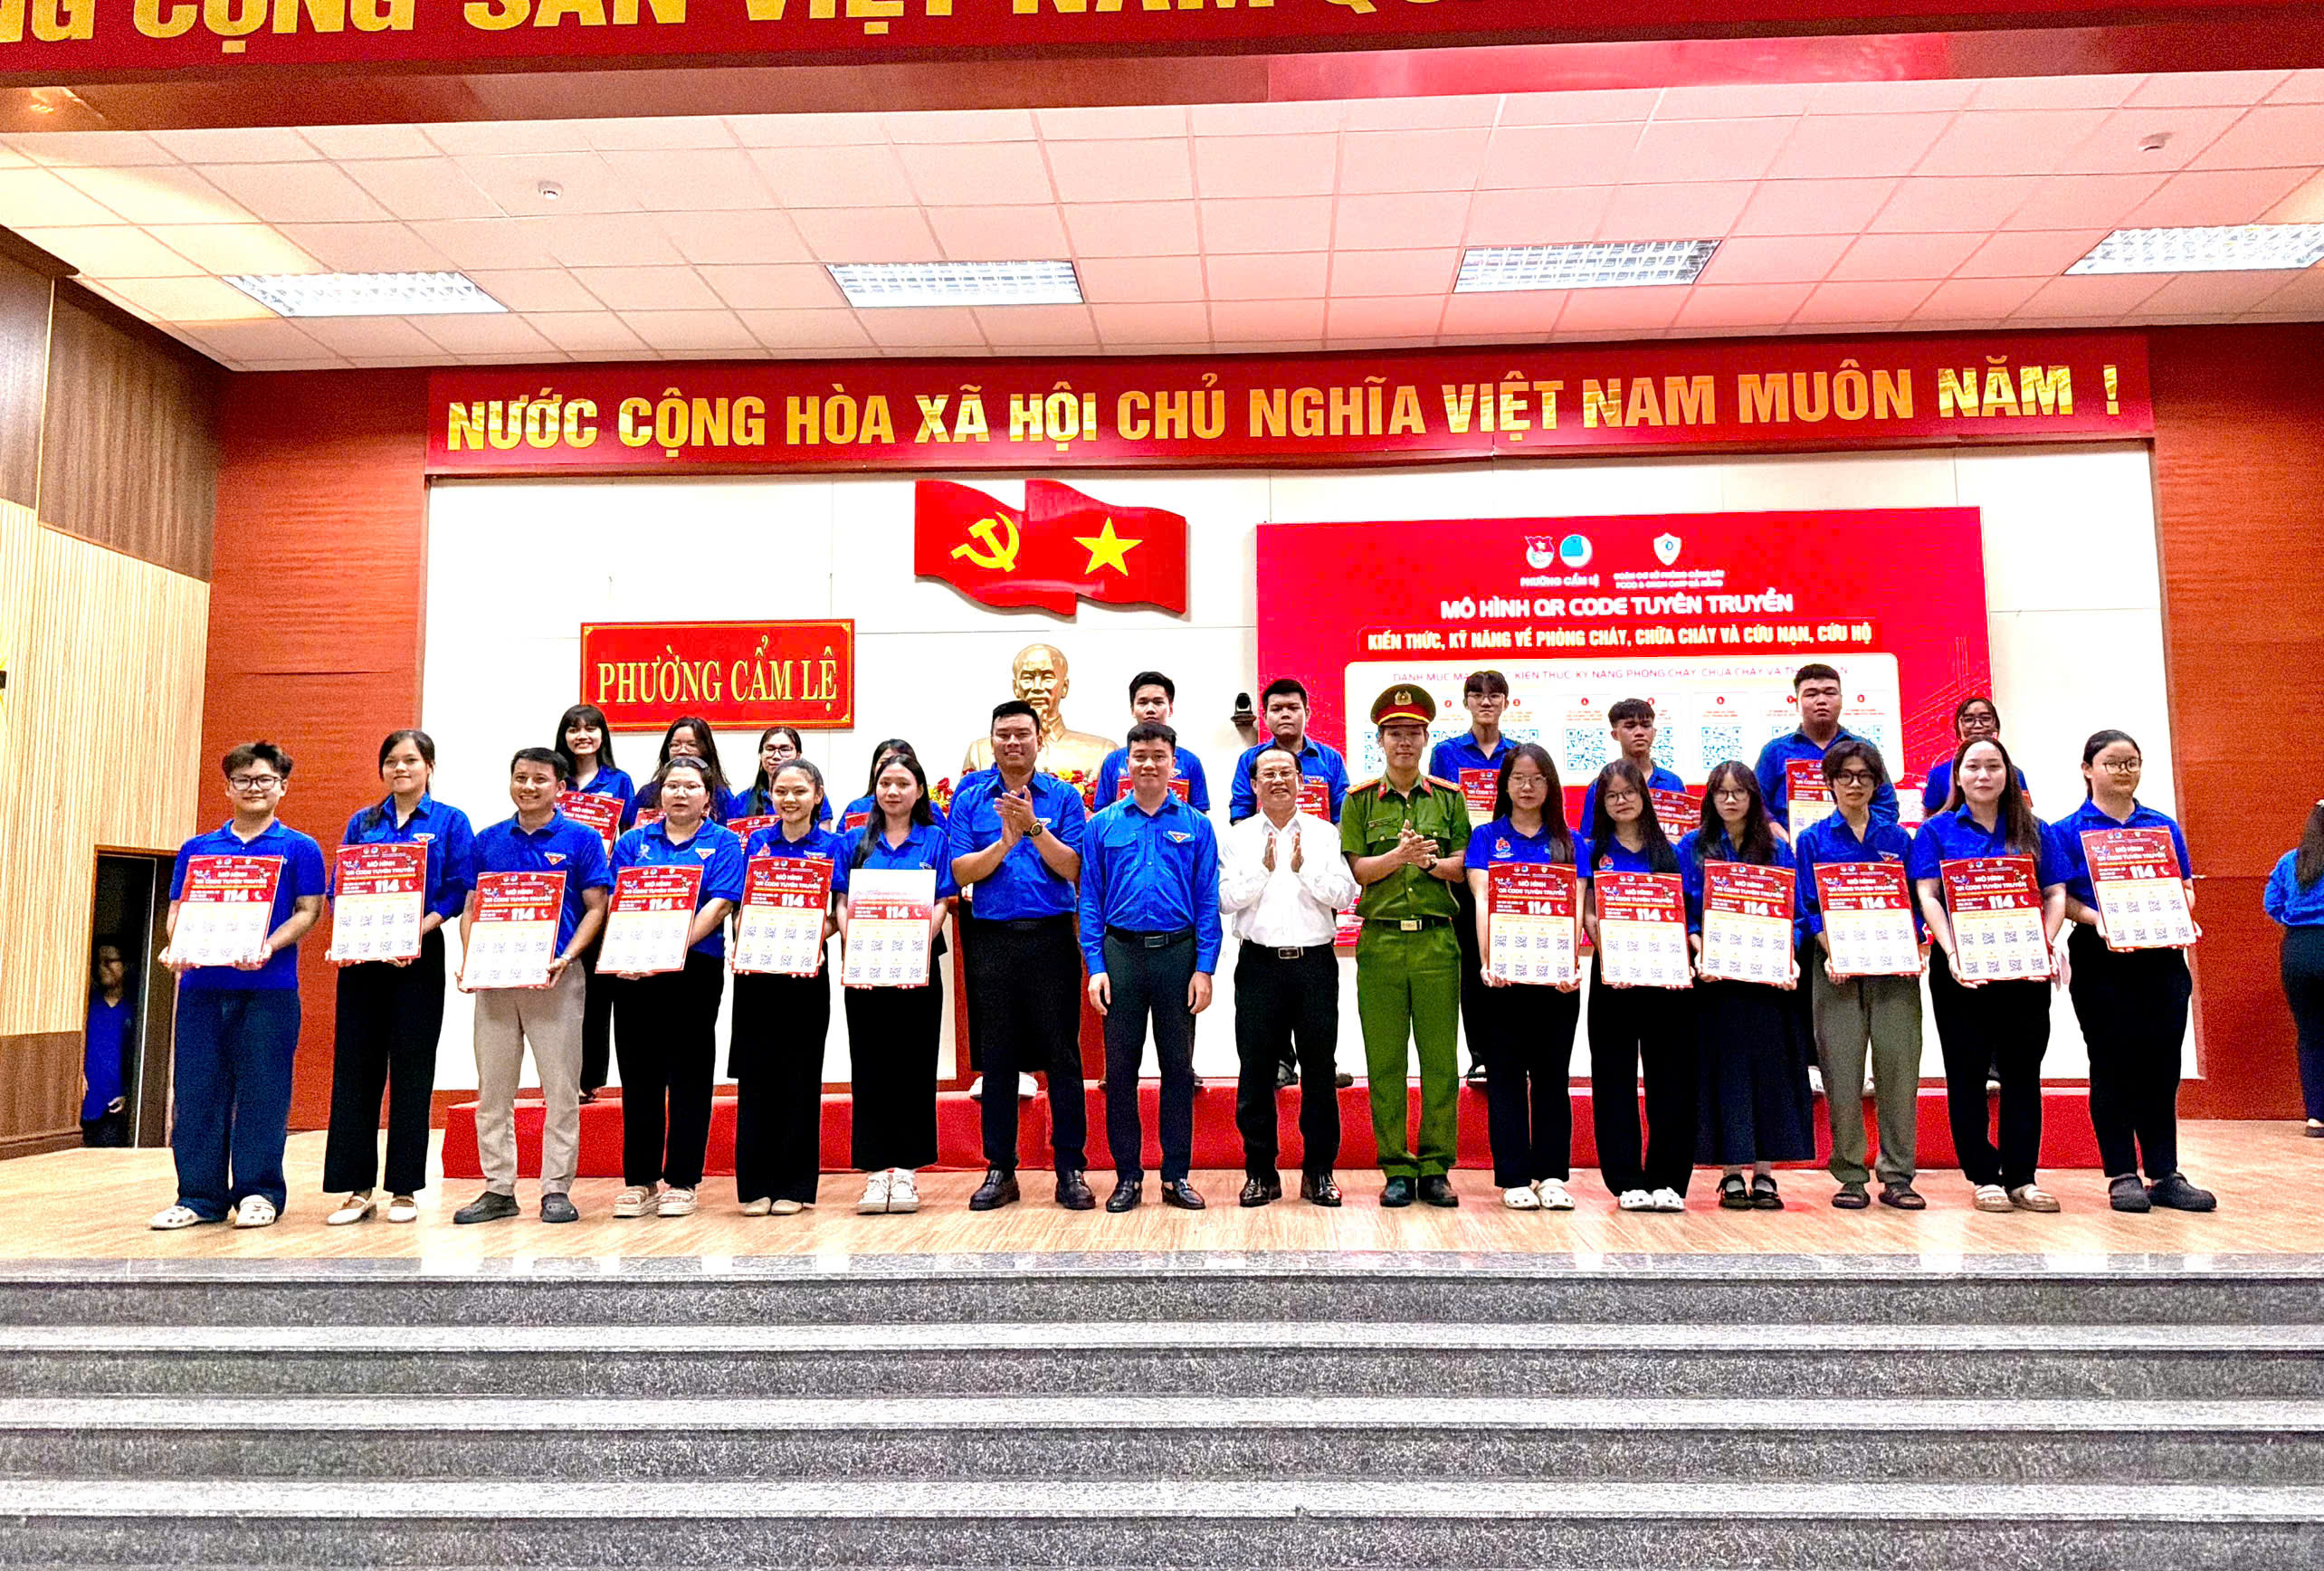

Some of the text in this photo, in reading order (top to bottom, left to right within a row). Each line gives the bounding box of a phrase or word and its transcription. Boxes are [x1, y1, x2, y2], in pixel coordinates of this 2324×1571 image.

[447, 355, 2120, 457] NƯỚC CỘNG HÒA XÃ HỘI CHỦ NGHĨA VIỆT NAM MUÔN NĂM !
[1441, 586, 1794, 619] MÔ HÌNH QR CODE TUYÊN TRUYỀN
[1368, 630, 1402, 650] KIẾN
[1405, 630, 1446, 651] THỨC,
[1449, 630, 1468, 649] KỸ
[1472, 630, 1511, 648] NĂNG
[1536, 626, 1586, 647] PHÒNG
[1589, 626, 1632, 647] CHÁY,
[1635, 625, 1675, 645] CHỮA
[1678, 624, 1717, 644] CHÁY
[1719, 624, 1740, 643] VÀ
[1743, 624, 1774, 643] CỨU
[1776, 625, 1814, 646] NẠN,
[1817, 622, 1848, 643] CỨU
[1851, 622, 1872, 644] HỘ
[596, 634, 838, 713] PHƯỜNG CẨM LỆ
[1659, 822, 1679, 834] 114
[2129, 865, 2156, 879] 114
[376, 880, 399, 892] 114
[224, 890, 249, 901] 114
[782, 893, 804, 907] 114
[1988, 894, 2014, 909] 114
[649, 898, 671, 910] 114
[1528, 901, 1551, 914] 114
[1744, 900, 1768, 915] 114
[1860, 897, 1886, 909] 114
[511, 908, 535, 920] 114
[886, 906, 909, 919] 114
[1636, 908, 1661, 920] 114
